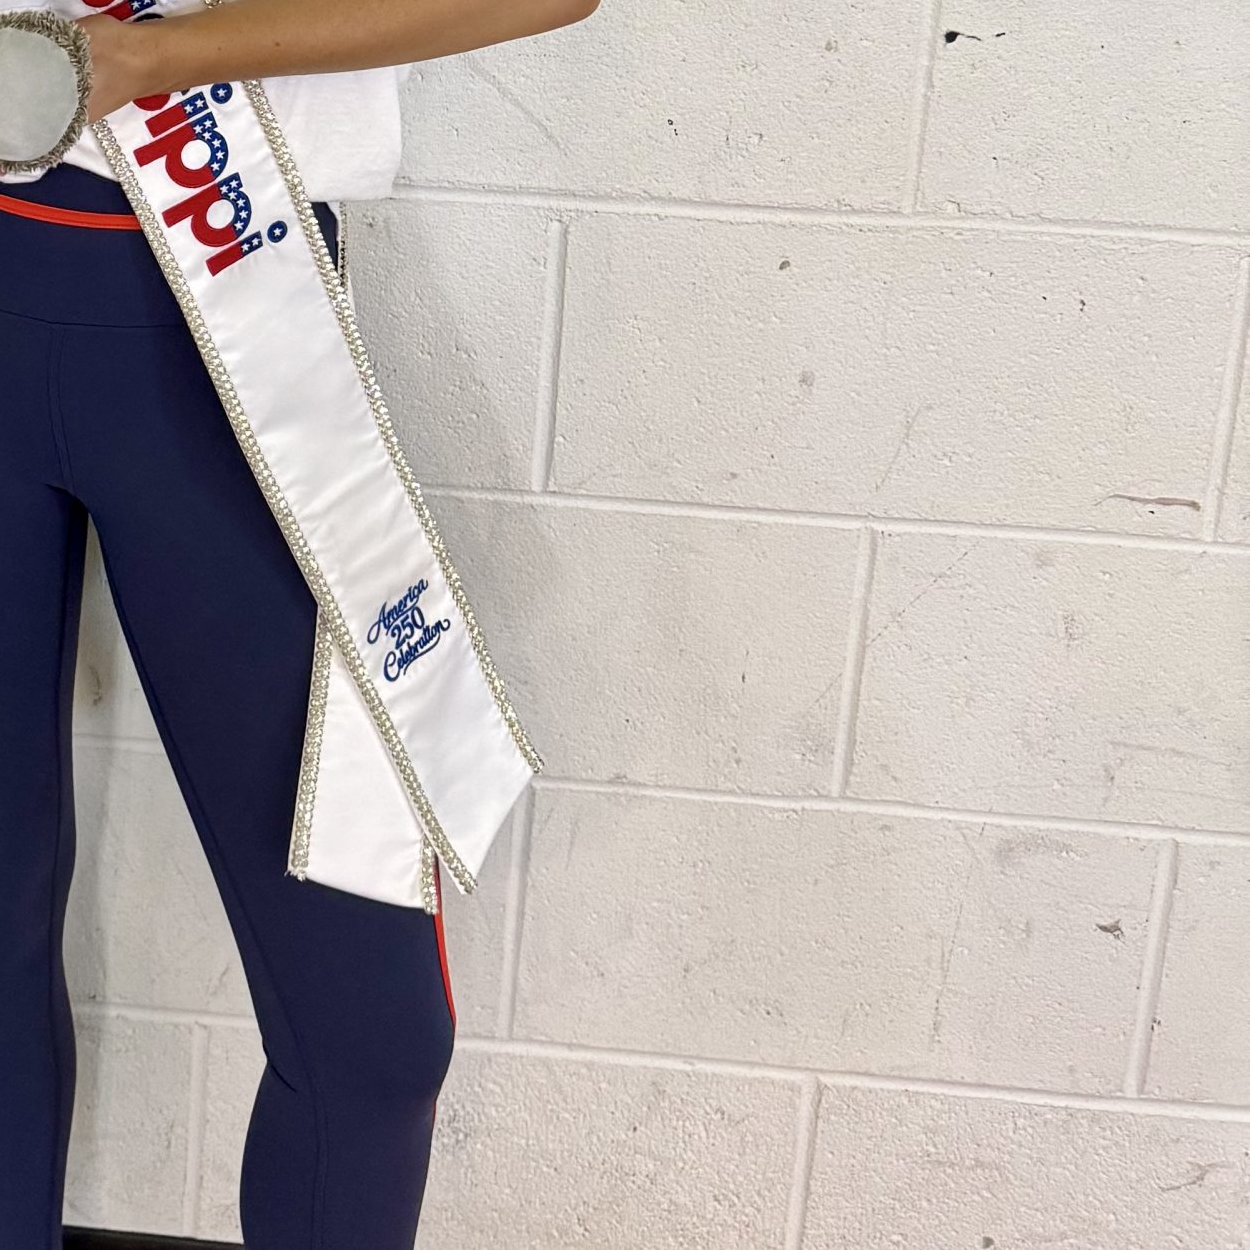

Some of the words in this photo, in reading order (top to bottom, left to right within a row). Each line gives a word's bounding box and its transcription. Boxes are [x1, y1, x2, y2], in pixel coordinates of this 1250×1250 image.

[366, 578, 429, 645] America
[390, 606, 425, 650] 250
[383, 618, 451, 682] Celebration
